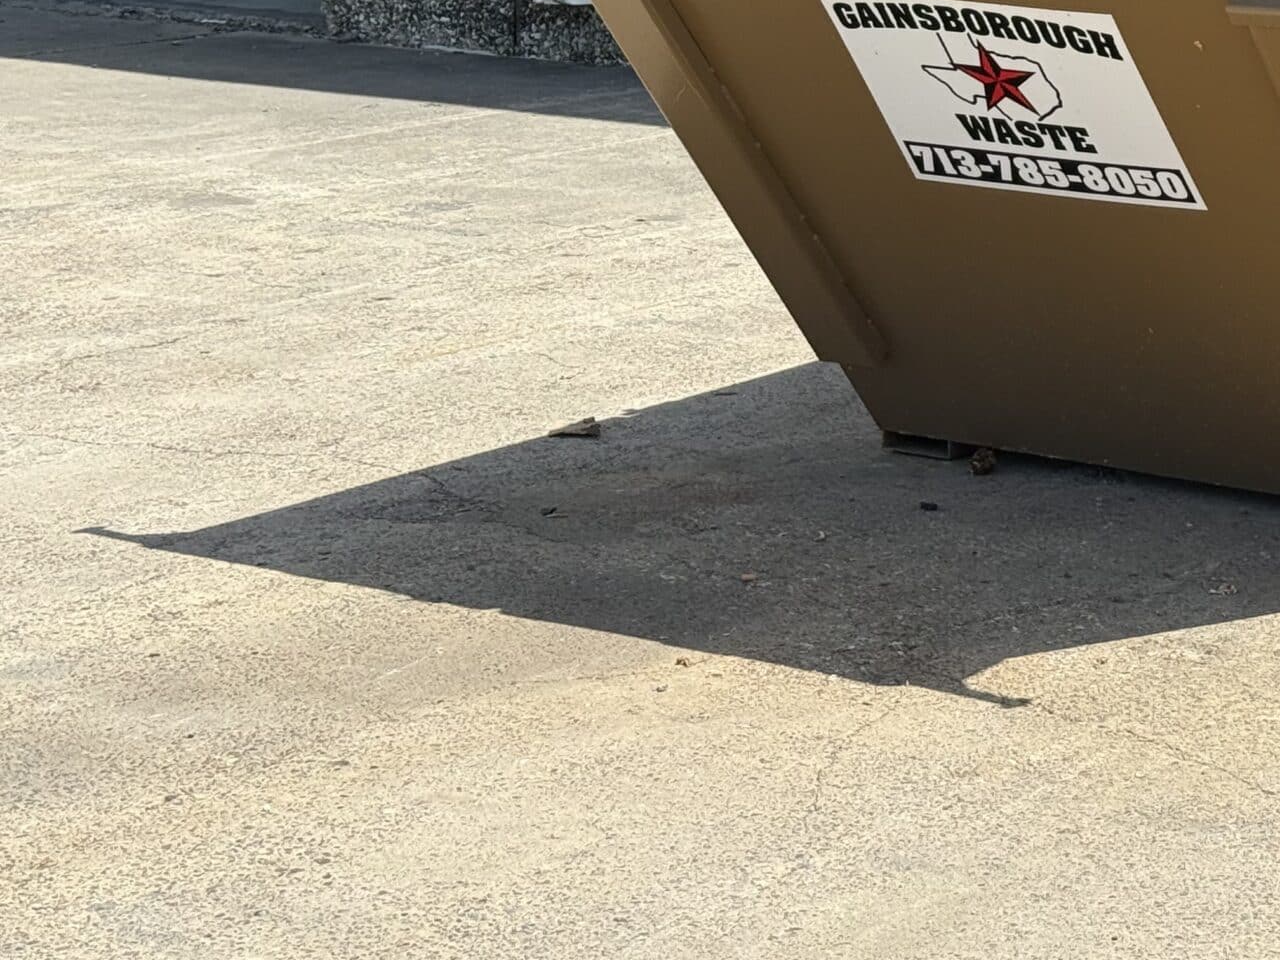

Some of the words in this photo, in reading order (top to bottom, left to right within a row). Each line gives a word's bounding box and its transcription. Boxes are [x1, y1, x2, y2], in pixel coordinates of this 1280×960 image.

[832, 1, 1125, 61] GAINSBOROUGH
[955, 113, 1099, 154] WASTE
[914, 147, 1190, 201] 713-785-8050
